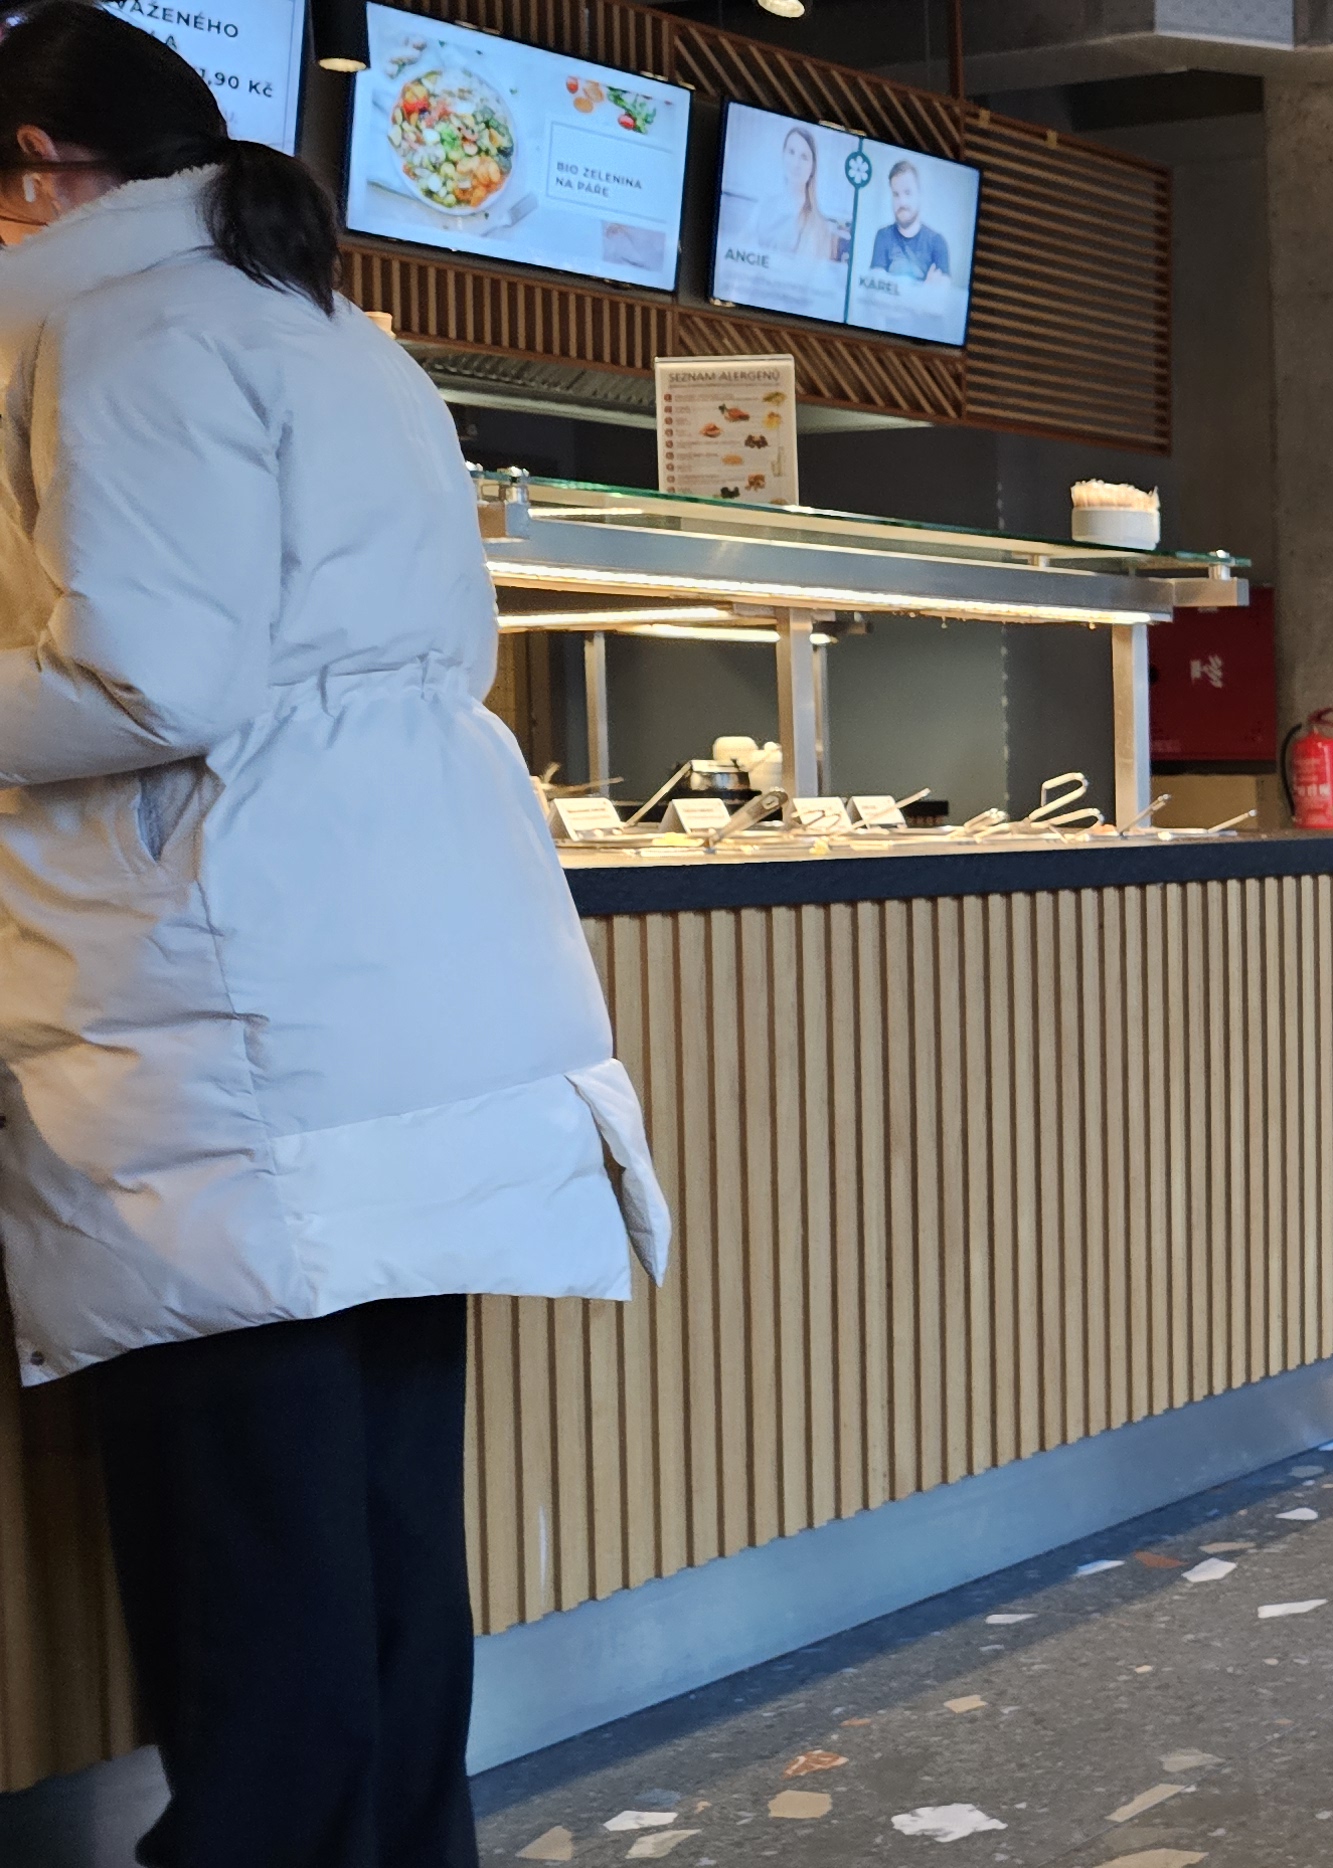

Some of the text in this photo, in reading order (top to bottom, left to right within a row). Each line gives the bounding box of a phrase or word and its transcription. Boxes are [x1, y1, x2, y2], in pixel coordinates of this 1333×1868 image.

[248, 79, 273, 98] Kč
[556, 161, 642, 190] BIO ZELENINA
[556, 177, 573, 189] NA
[859, 275, 900, 297] KAREL
[669, 371, 716, 383] SEZNAM
